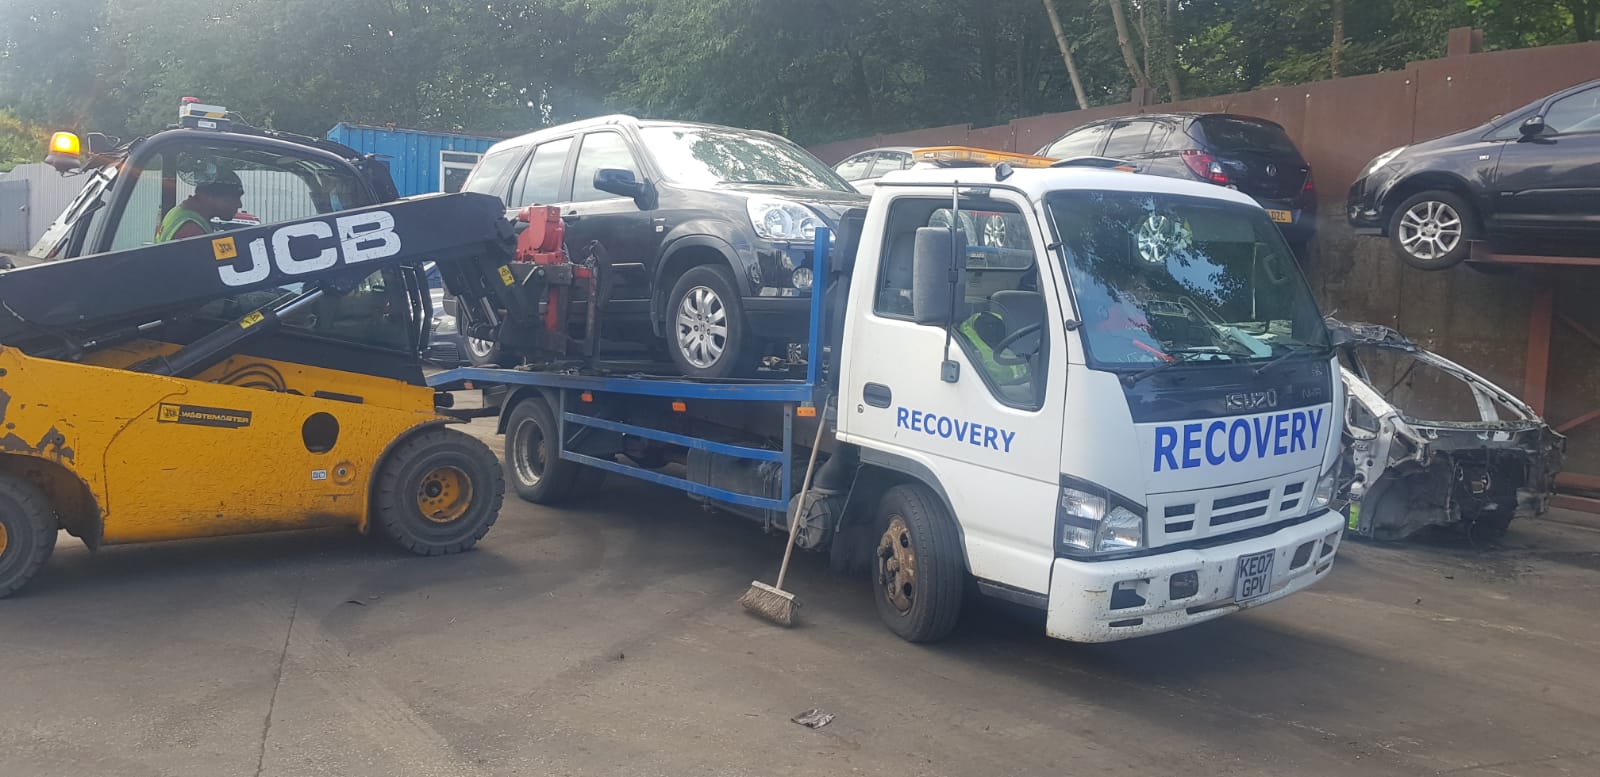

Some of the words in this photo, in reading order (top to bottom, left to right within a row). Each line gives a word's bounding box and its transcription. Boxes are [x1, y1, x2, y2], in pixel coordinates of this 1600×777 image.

[217, 210, 401, 286] JCB
[1225, 389, 1277, 409] ISUZU
[181, 411, 249, 423] WASTEMASTER
[897, 406, 1016, 453] RECOVERY
[1153, 408, 1323, 472] RECOVERY
[1240, 553, 1273, 578] KE07
[1242, 574, 1267, 597] GPV
